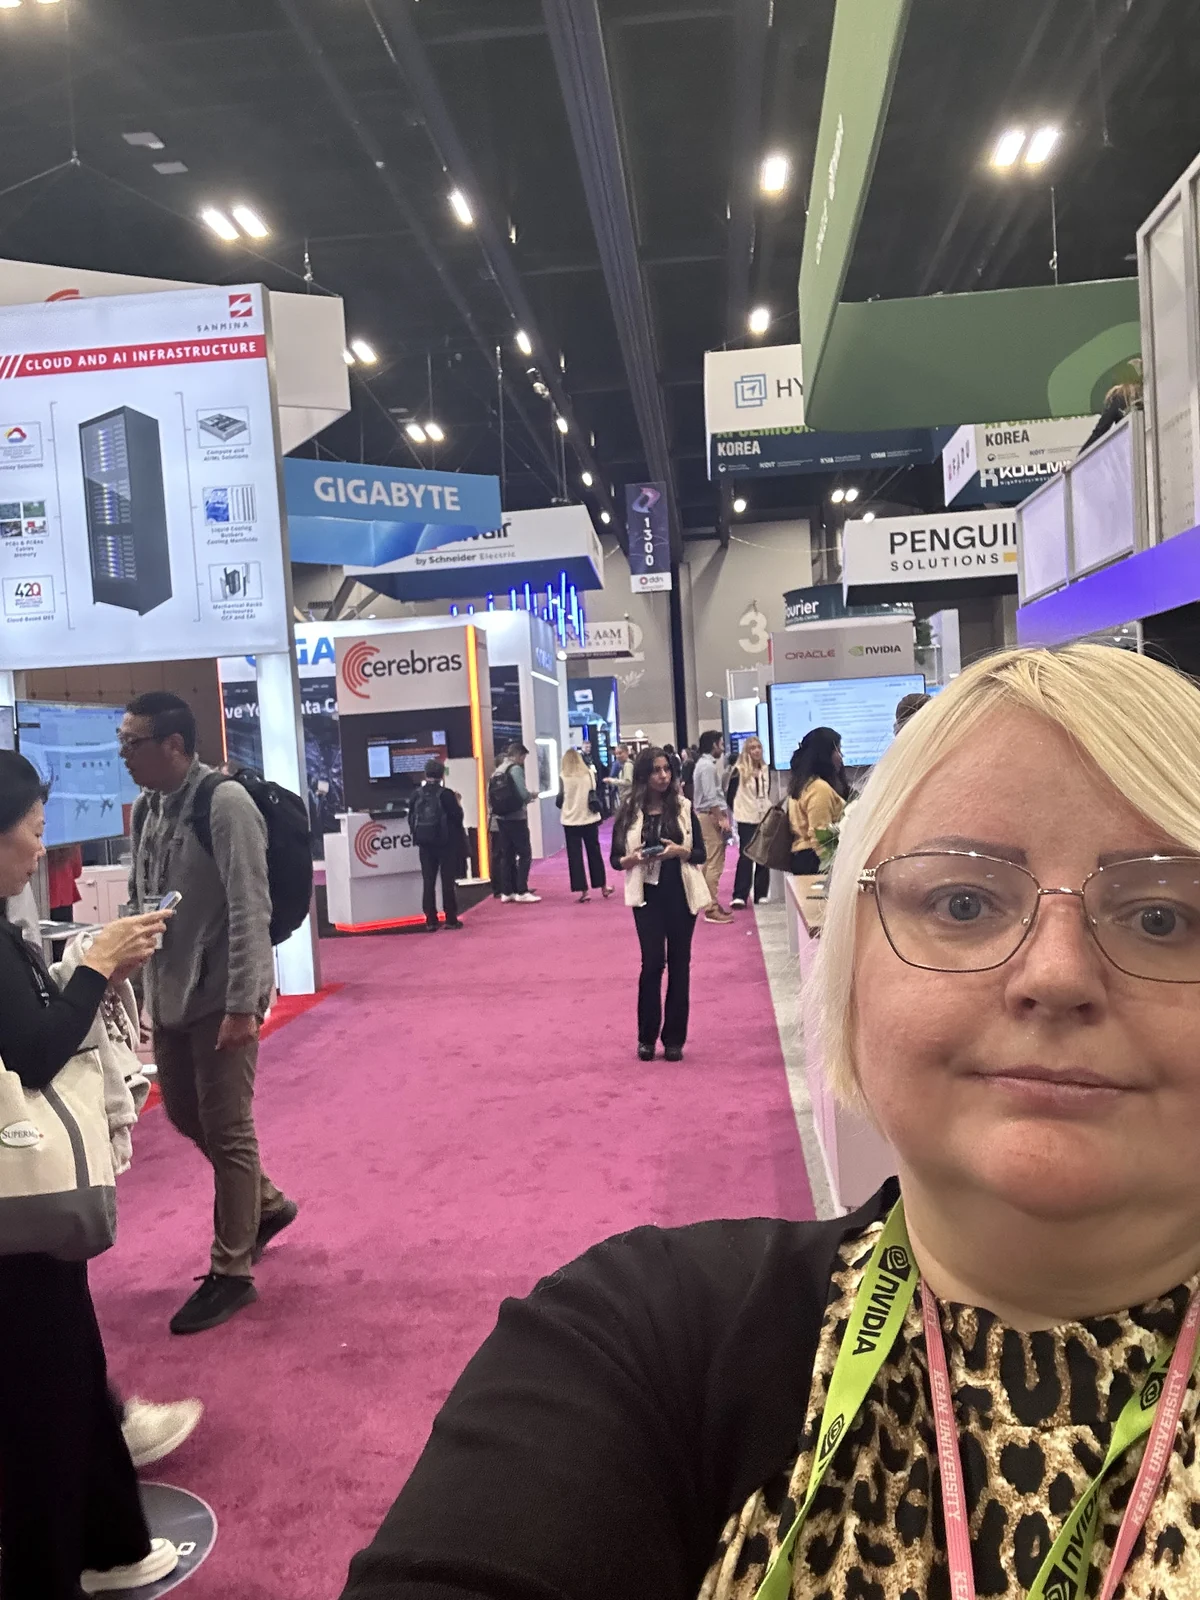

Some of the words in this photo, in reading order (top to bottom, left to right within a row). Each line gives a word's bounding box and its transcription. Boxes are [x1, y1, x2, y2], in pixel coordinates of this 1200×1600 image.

[197, 322, 250, 333] SANMINA
[25, 358, 72, 372] CLOUD
[78, 355, 108, 368] AND
[112, 353, 128, 364] AI
[132, 341, 257, 363] INFRASTRUCTURE
[717, 440, 762, 456] KOREA
[985, 429, 1030, 447] KOREA
[314, 476, 462, 512] GIGABYTE
[643, 516, 655, 567] 1300
[890, 521, 1017, 556] PENGUI
[416, 557, 427, 567] by
[429, 554, 476, 565] Schneider
[479, 550, 516, 561] Electric
[890, 552, 1000, 572] SOLUTIONS
[594, 627, 623, 641] A&M
[739, 611, 769, 653] 3
[361, 649, 462, 680] cerebras
[785, 648, 836, 660] ORACLE
[865, 644, 902, 655] NVIDIA
[852, 1274, 900, 1356] NVIDIA
[933, 1368, 949, 1415] KEAN
[1131, 1478, 1156, 1526] KEAN
[1149, 1369, 1185, 1475] UNIVERSITY
[939, 1420, 962, 1522] UNIVERSITY
